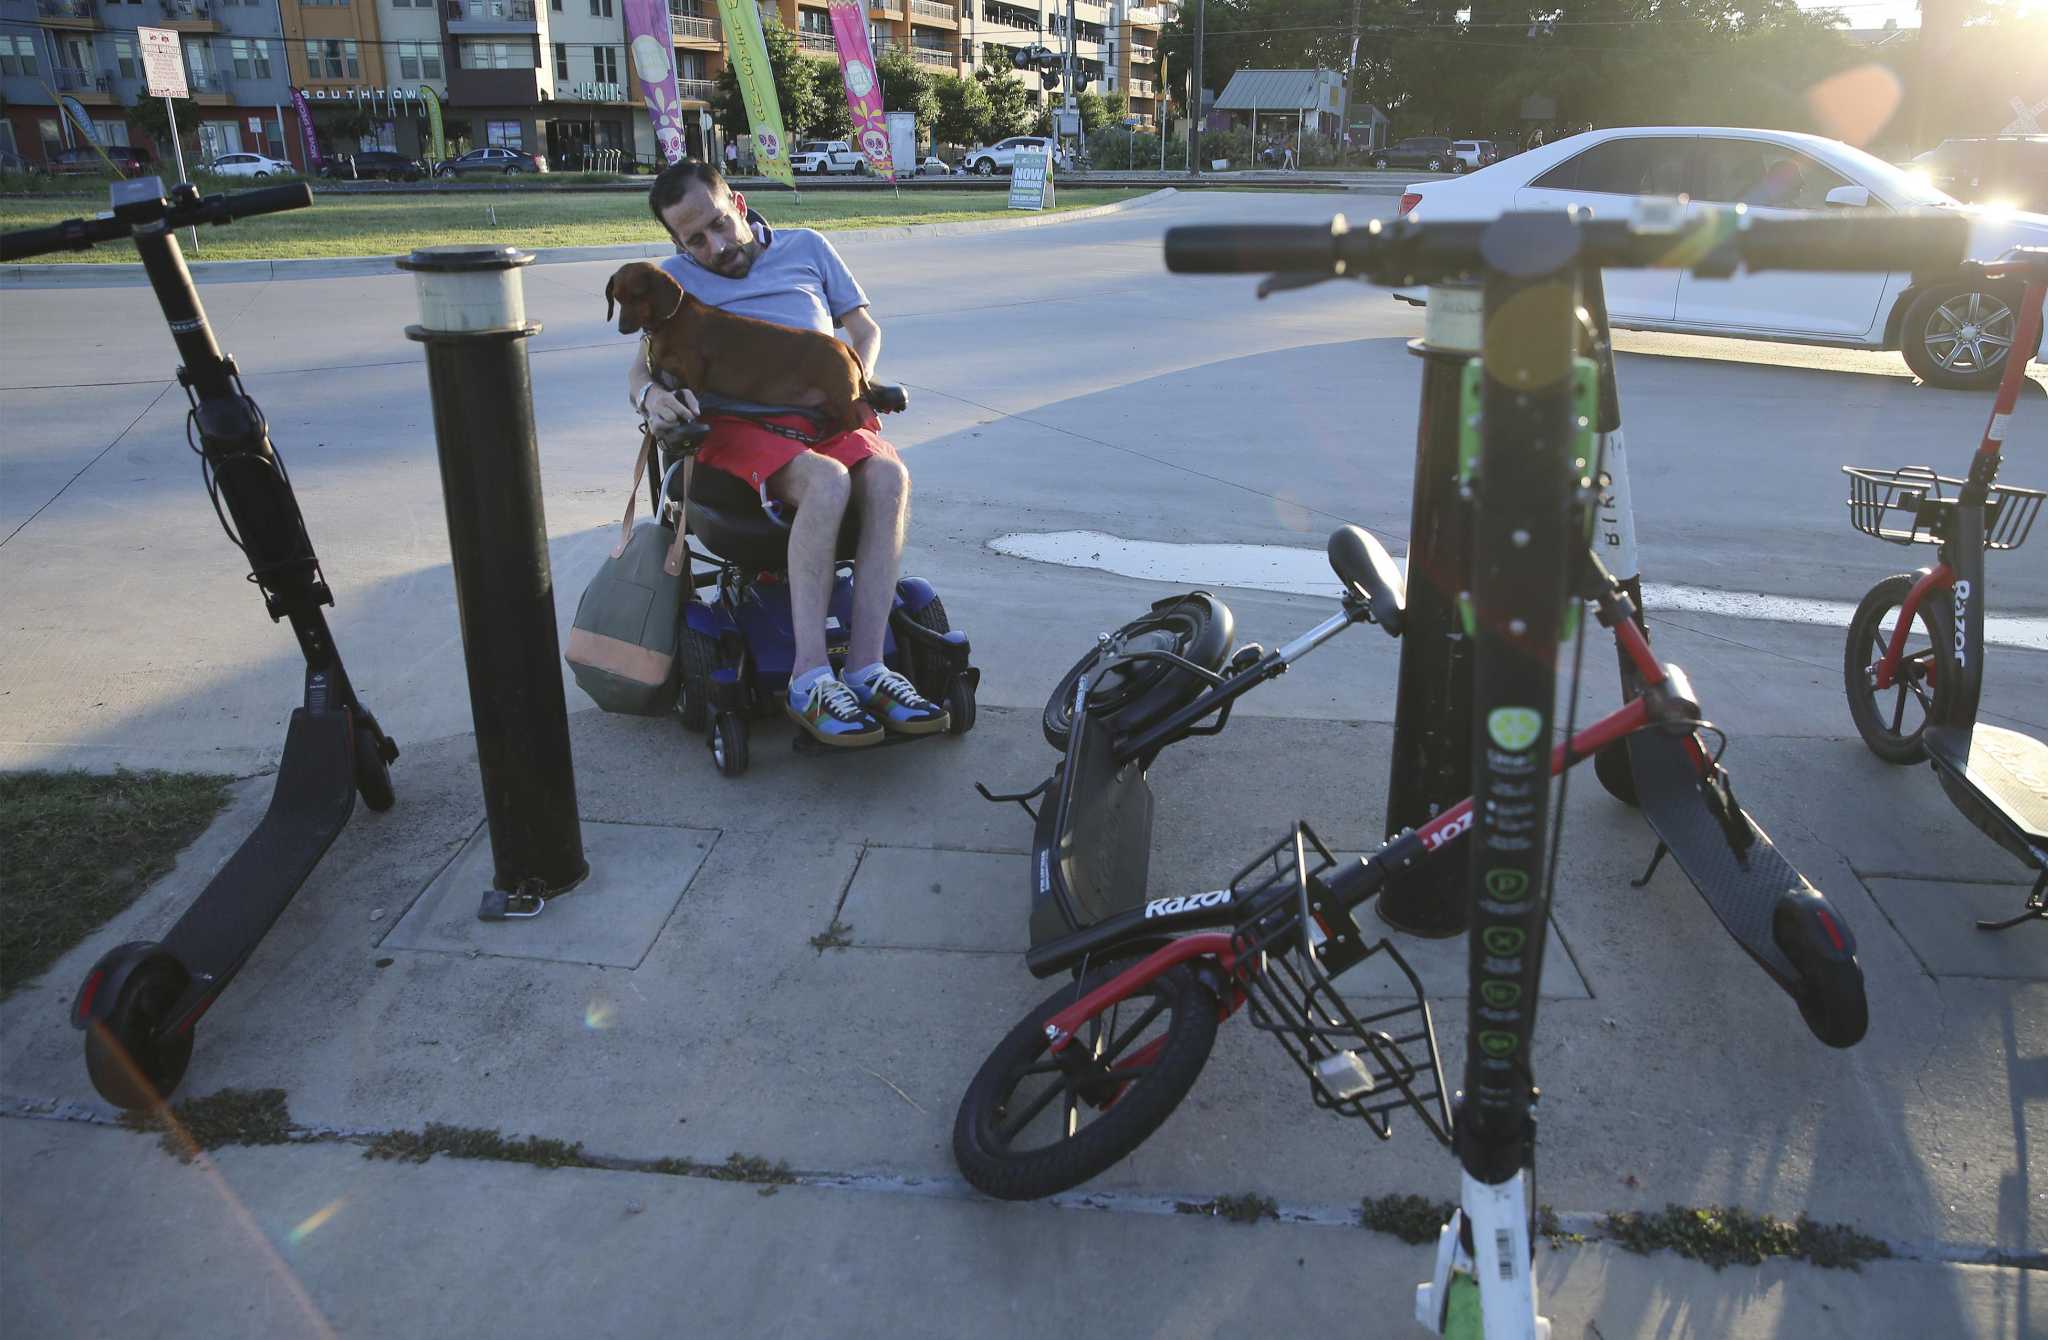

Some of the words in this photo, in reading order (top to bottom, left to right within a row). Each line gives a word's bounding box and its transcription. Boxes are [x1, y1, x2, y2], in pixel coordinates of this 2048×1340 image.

[301, 89, 423, 100] SOUTHTOW
[1015, 168, 1044, 180] NOW
[1954, 580, 1970, 668] Razor
